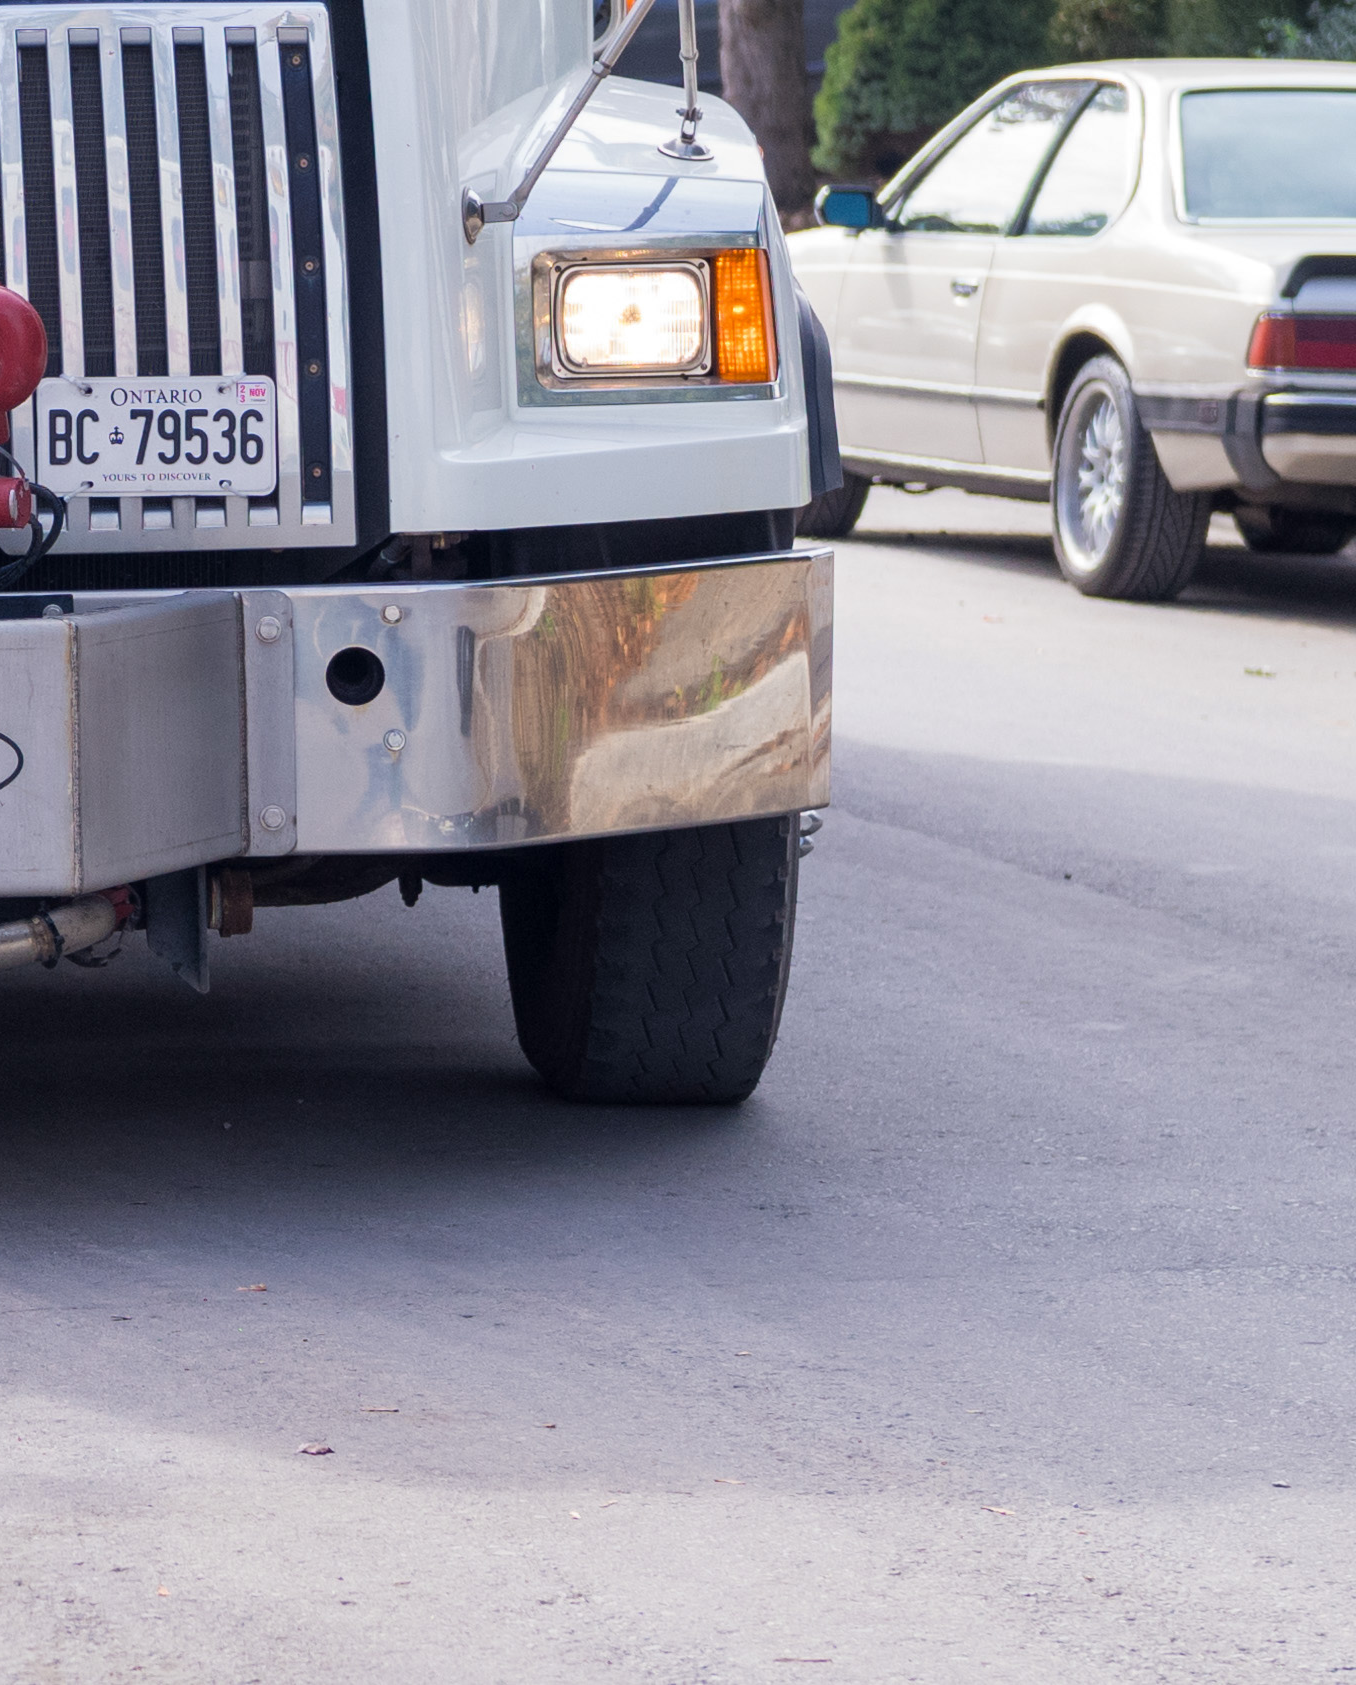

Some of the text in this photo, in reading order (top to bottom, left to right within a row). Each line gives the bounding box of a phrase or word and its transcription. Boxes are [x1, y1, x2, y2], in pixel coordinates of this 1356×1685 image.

[249, 388, 266, 397] NOV
[102, 473, 212, 482] YOURS TO DISCOVER
